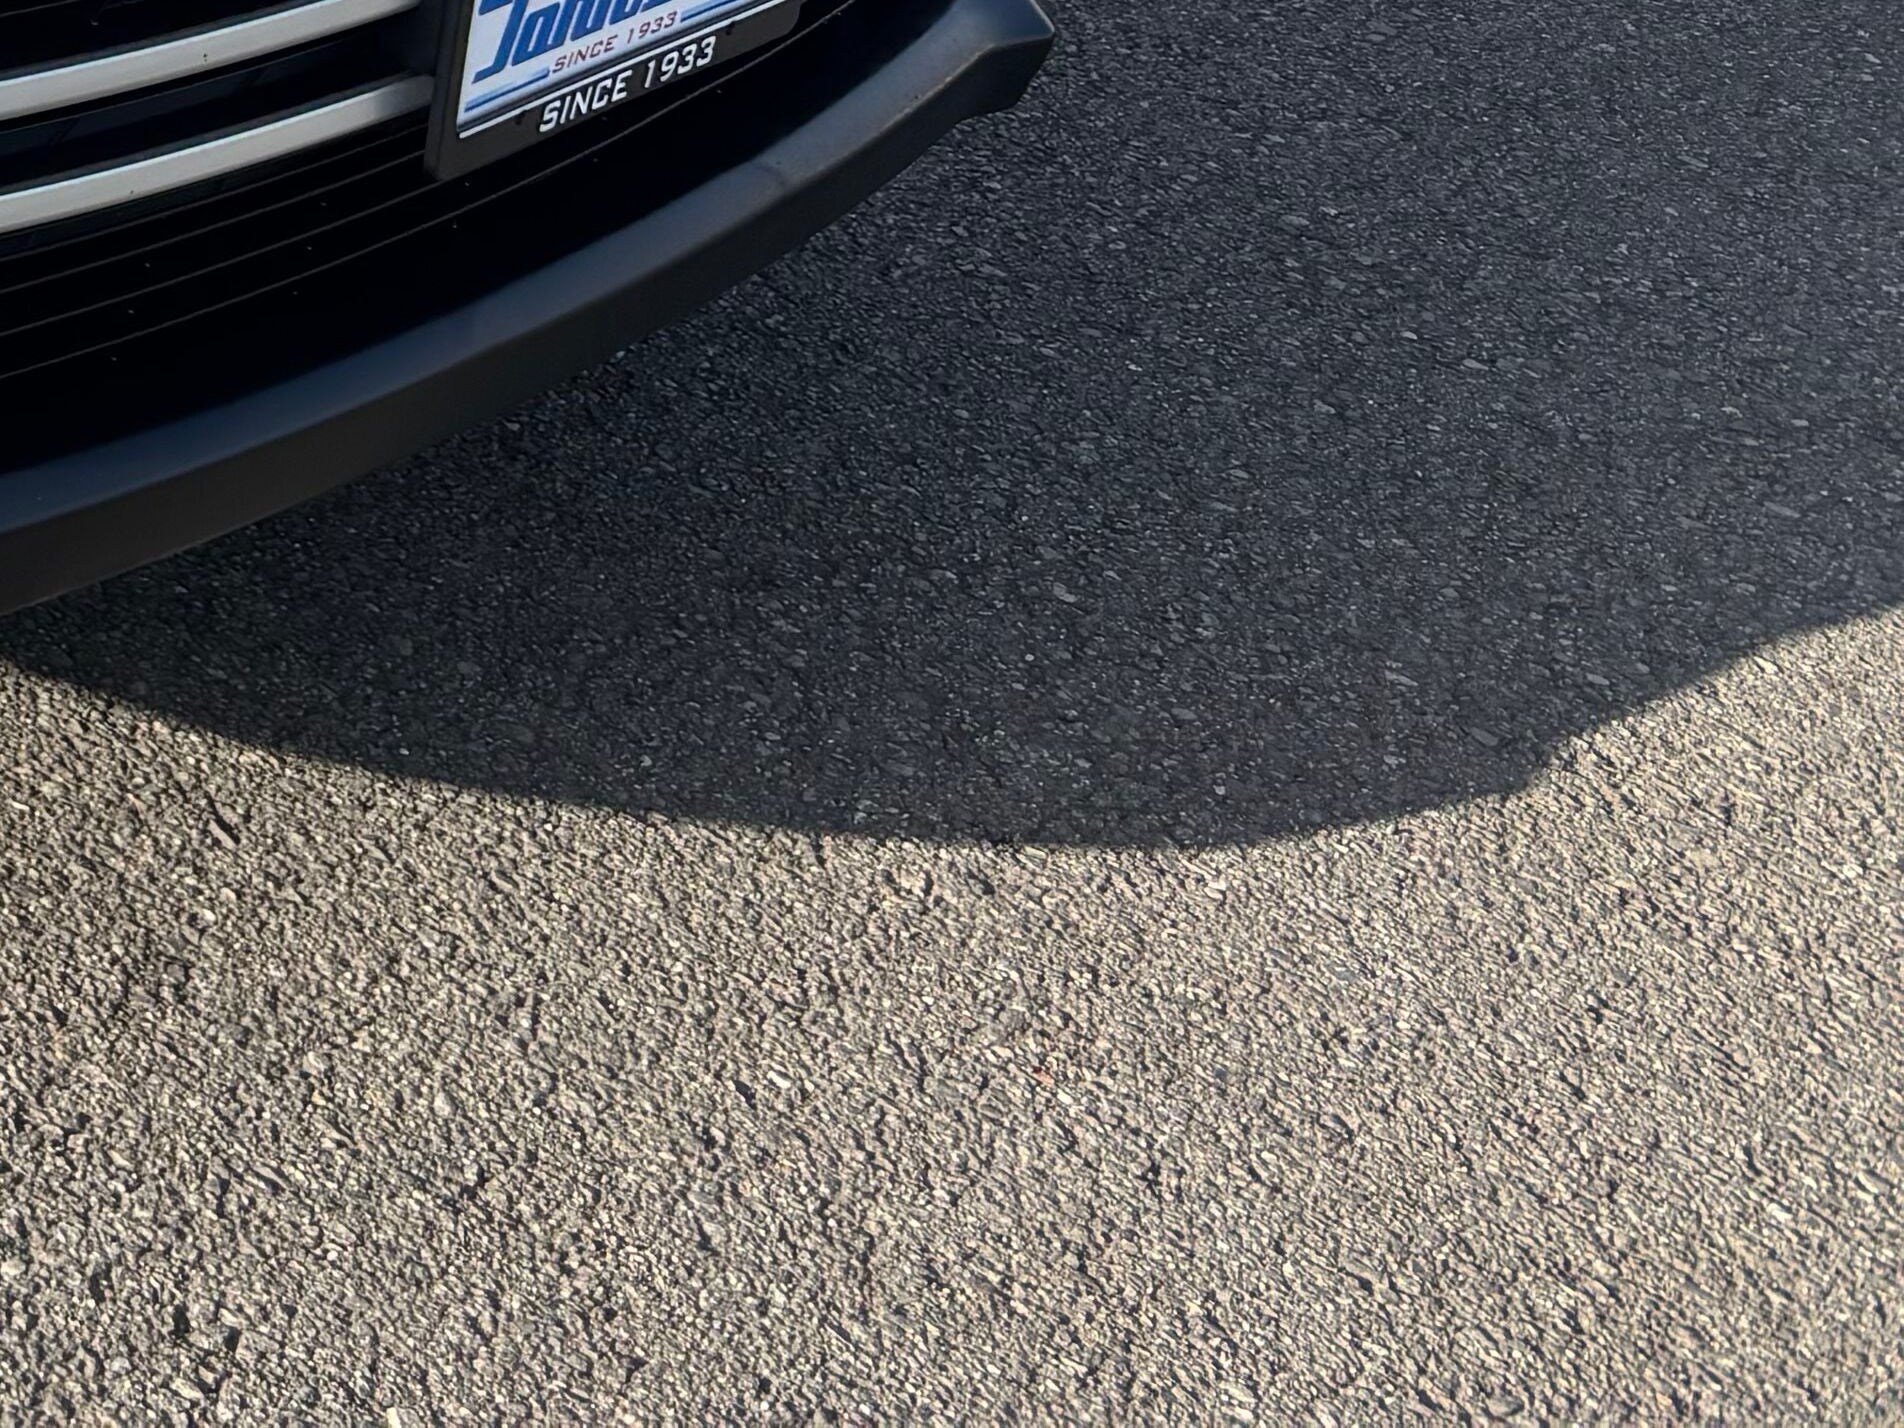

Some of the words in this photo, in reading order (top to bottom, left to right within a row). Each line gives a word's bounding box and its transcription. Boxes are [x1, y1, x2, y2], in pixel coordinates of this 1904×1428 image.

[551, 33, 619, 74] SINCE
[625, 10, 679, 44] 1933
[539, 69, 633, 133] SINCE
[644, 35, 717, 89] 1933
